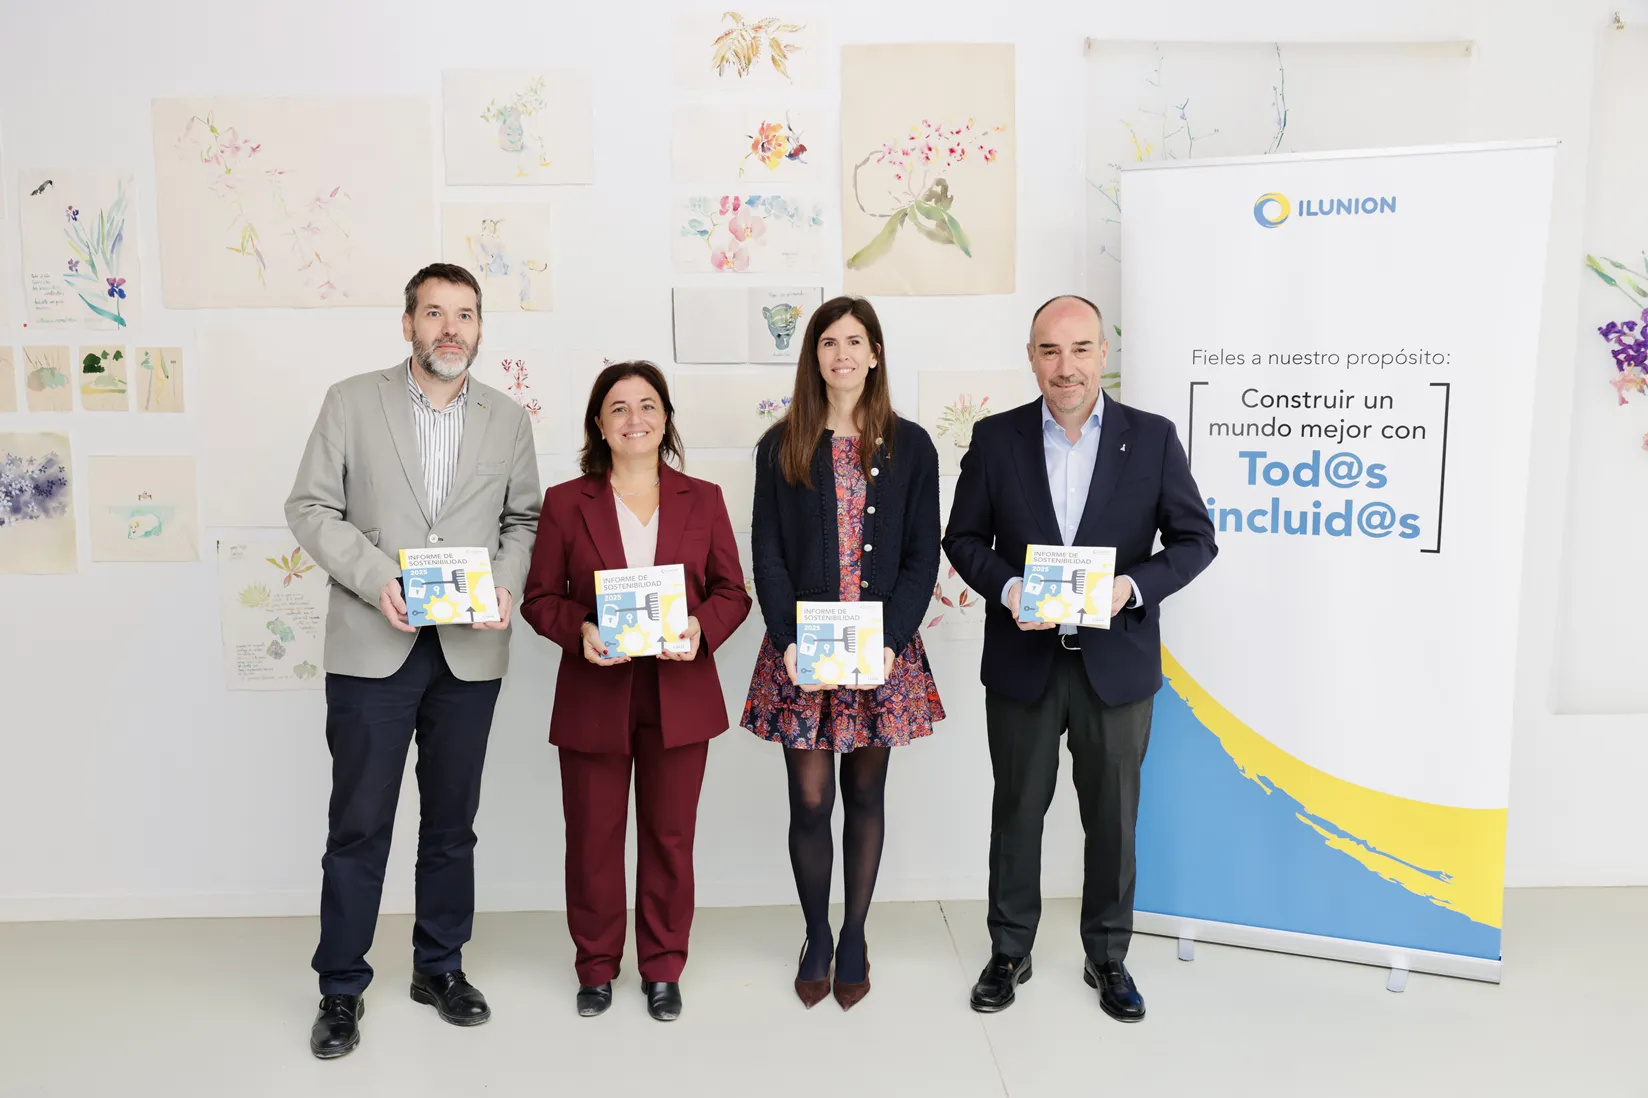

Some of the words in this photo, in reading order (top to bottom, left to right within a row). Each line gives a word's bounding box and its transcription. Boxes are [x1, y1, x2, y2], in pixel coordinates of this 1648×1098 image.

[1298, 196, 1397, 217] ILUNION
[1192, 349, 1245, 366] Fieles
[1251, 354, 1262, 365] a
[1268, 350, 1340, 366] nuestro
[1346, 349, 1450, 369] propósito:
[1241, 388, 1355, 410] Construir
[1364, 395, 1393, 409] un
[1209, 416, 1292, 438] mundo
[1300, 418, 1372, 444] mejor
[1381, 424, 1426, 440] con
[1238, 449, 1388, 489] Tod@s
[1207, 497, 1421, 539] incluid@s
[408, 559, 468, 567] SOSTENIBILIDAD
[1033, 557, 1092, 565] SOSTENIBILIDAD
[603, 575, 636, 584] INFORME
[603, 580, 662, 591] SOSTENIBILIDAD
